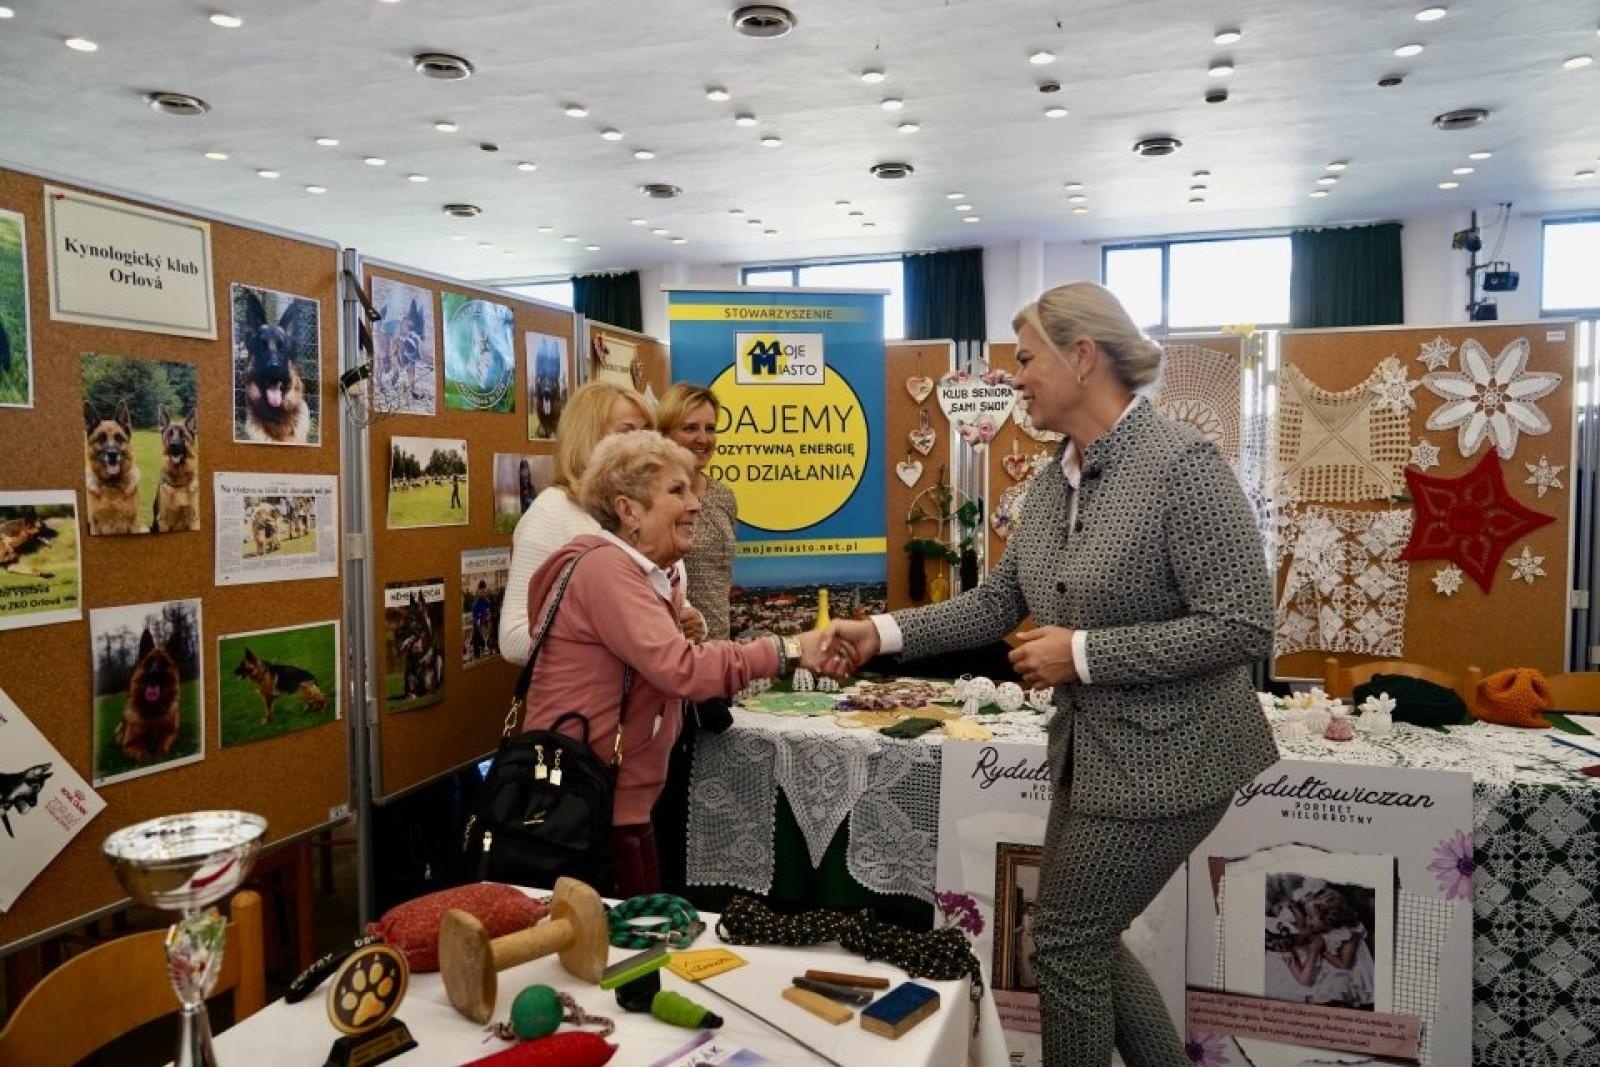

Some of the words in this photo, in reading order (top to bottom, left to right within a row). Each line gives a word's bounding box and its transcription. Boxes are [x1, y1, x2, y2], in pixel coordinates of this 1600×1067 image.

[64, 236, 163, 271] Kynologický
[167, 257, 199, 276] klub
[109, 268, 163, 290] Orlová
[724, 308, 833, 319] STOWARZYSZENIE
[942, 388, 968, 398] KLUB
[971, 387, 1014, 398] SENIORA
[715, 404, 854, 434] DAJEMY
[714, 444, 794, 457] OZYTYWNĄ
[799, 442, 855, 457] ENERGIĘ
[709, 465, 741, 483] DO
[747, 463, 855, 482] DZIAŁANIA
[1234, 774, 1436, 809] ydułtowiczan
[1280, 809, 1374, 825] WIELOKROTNY
[1294, 802, 1353, 814] PORTRET
